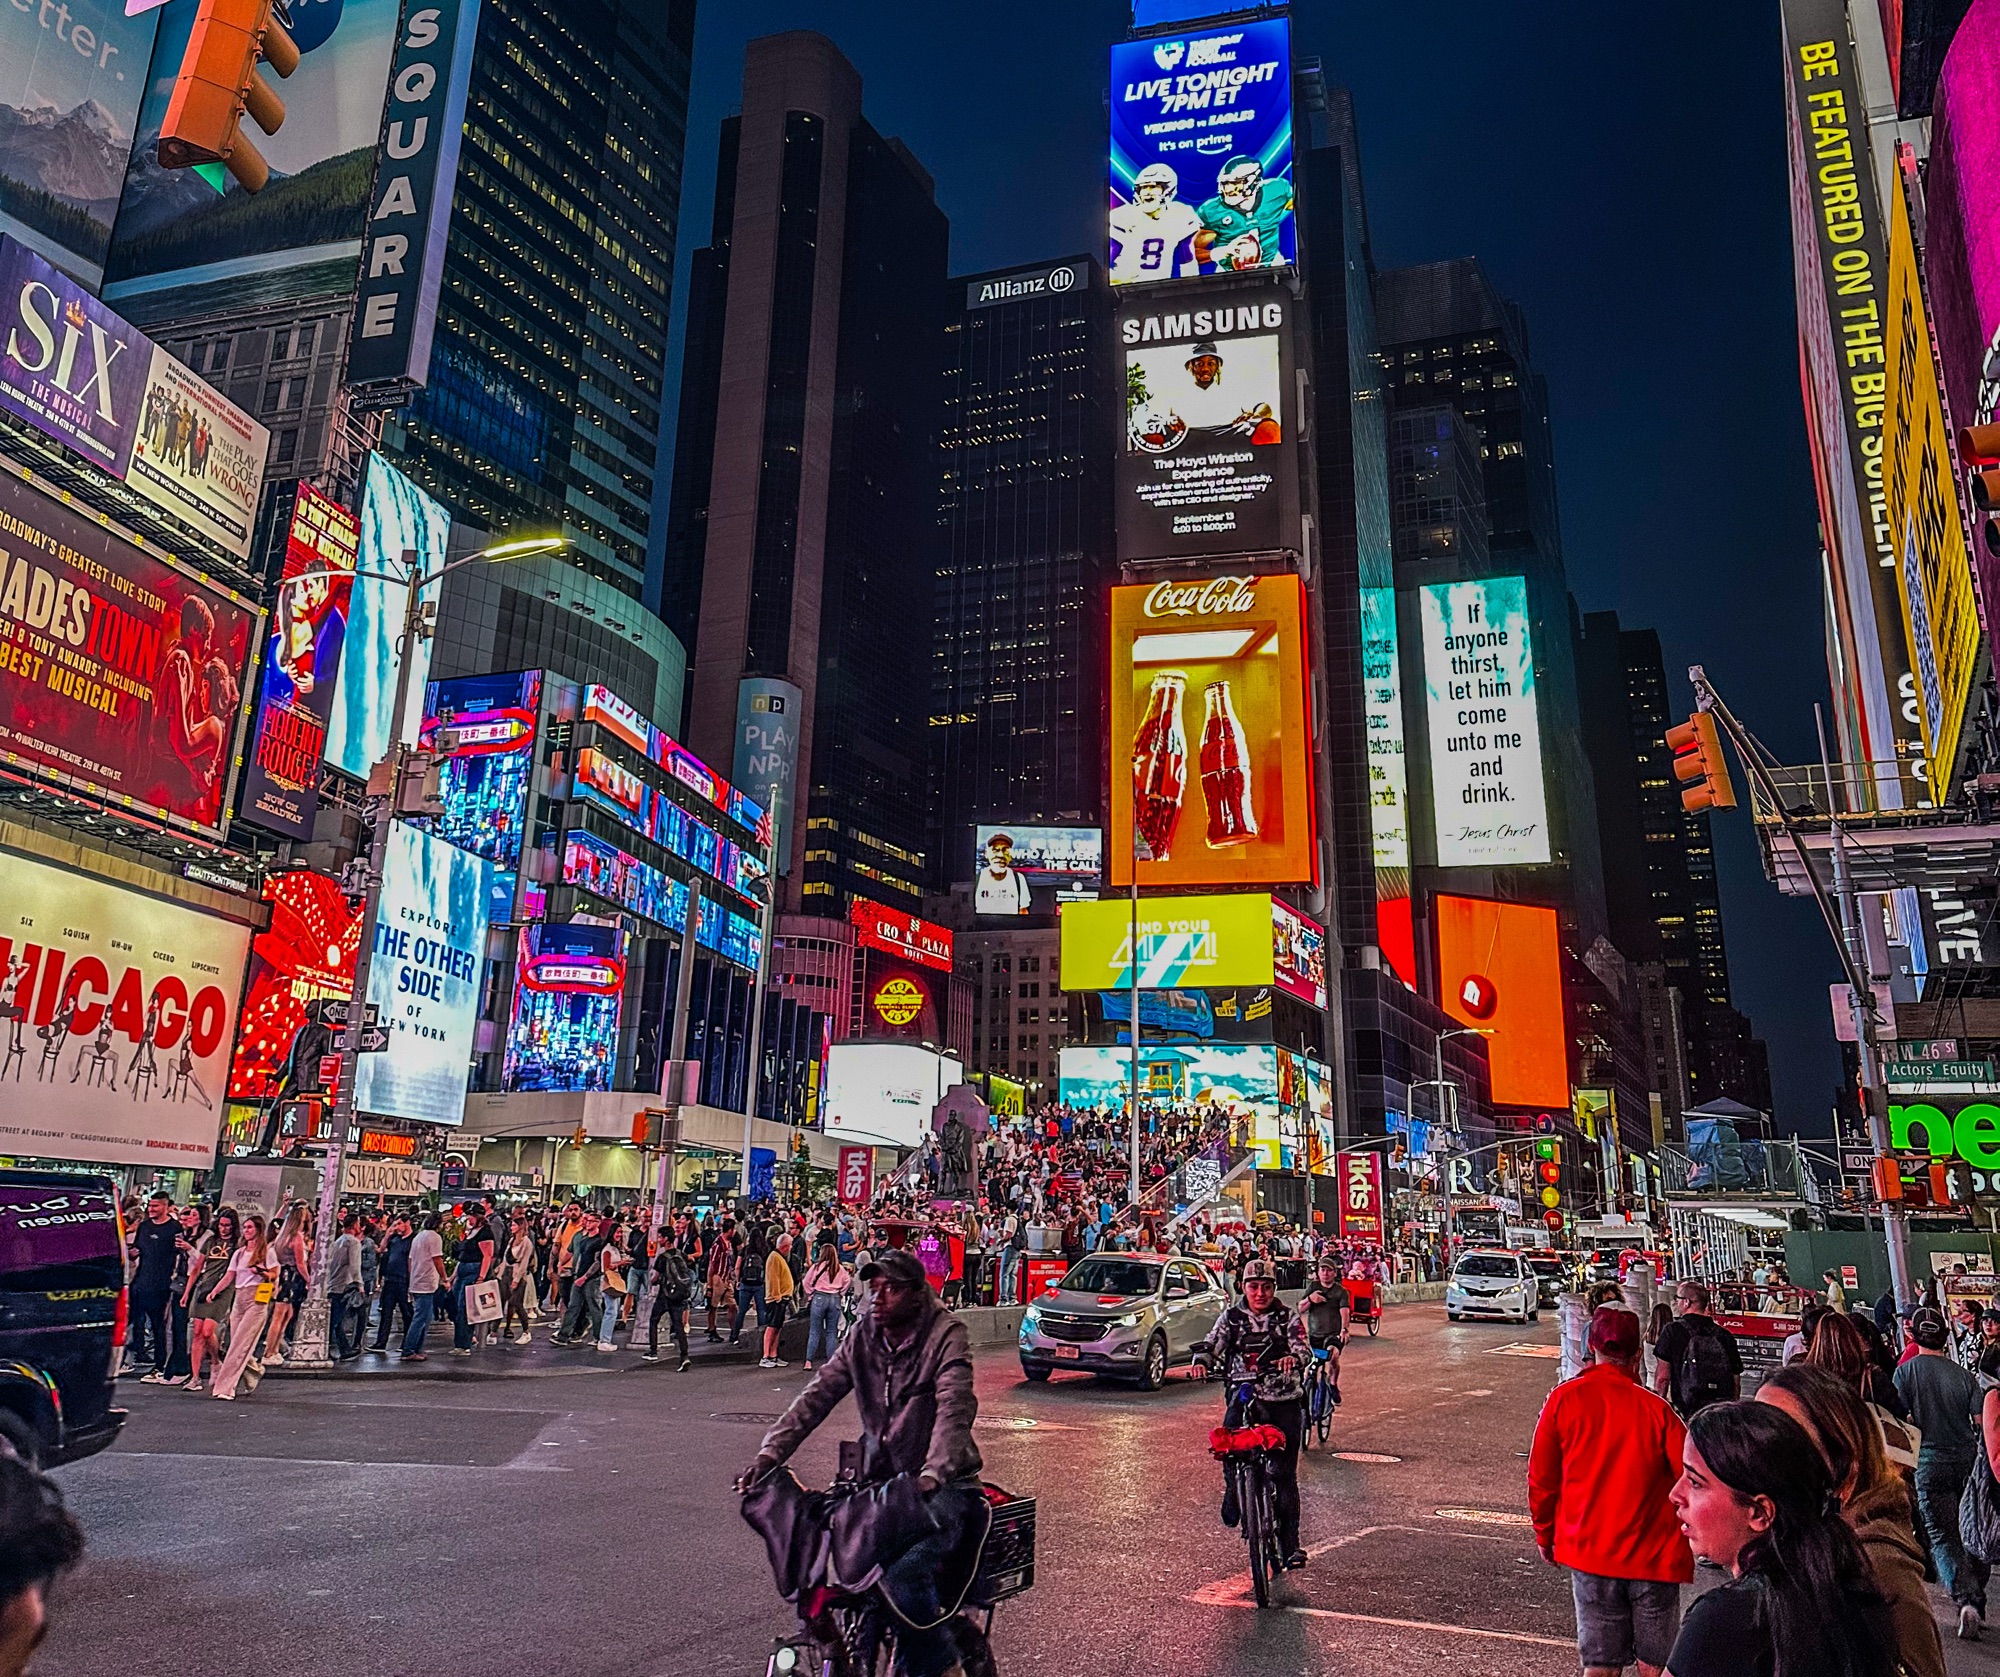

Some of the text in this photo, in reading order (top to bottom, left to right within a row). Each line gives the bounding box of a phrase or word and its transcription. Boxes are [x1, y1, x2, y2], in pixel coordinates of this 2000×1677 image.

[1124, 61, 1279, 102] LIVE TONIGHT
[1160, 85, 1242, 114] 7PM ET
[1144, 118, 1195, 135] VIKINGS
[1159, 134, 1233, 152] It's on prime
[361, 9, 442, 339] SQUARE
[1800, 41, 1886, 429] BE FEATURED ON THE BIG
[980, 277, 1045, 301] Allianz
[1122, 303, 1282, 345] SAMSUNG
[7, 282, 127, 426] SIX
[164, 372, 177, 385] AND
[31, 379, 93, 431] THE MUSICAL
[219, 436, 258, 471] THE PLAY
[1153, 452, 1253, 470] The Maya Winston
[213, 446, 259, 489] THAT GOES
[1172, 466, 1235, 481] Experience
[160, 476, 179, 494] WORLD
[179, 489, 197, 506] STAGES
[209, 459, 255, 510] WRONG
[1136, 483, 1152, 493] Join
[1162, 482, 1173, 491] for
[1185, 480, 1215, 488] evening
[1216, 478, 1225, 486] of
[1154, 499, 1171, 507] with
[1202, 495, 1218, 503] and
[1173, 512, 1235, 525] September 13
[1192, 524, 1202, 532] to
[58, 544, 168, 614] GREATEST LOVE STORY
[1144, 575, 1255, 618] Coca-Cola
[1468, 604, 1481, 624] If
[1444, 630, 1508, 655] anyone
[17, 628, 25, 643] 8
[29, 633, 56, 657] TONY
[103, 668, 152, 702] INCLUDING
[1451, 653, 1505, 676] thirst,
[0, 641, 117, 717] BEST MUSICAL
[1449, 678, 1512, 701] let him
[1457, 707, 1507, 726] come
[262, 704, 316, 757] MOULIN
[1447, 732, 1522, 753] unto me
[1470, 755, 1503, 777] and
[264, 792, 299, 813] NOW ON
[1462, 781, 1516, 805] drink.
[255, 799, 303, 824] BROADWAY
[1458, 823, 1538, 841] Jesus Christ
[1011, 849, 1040, 860] WHO
[1044, 860, 1098, 870] THE CALL
[20, 916, 34, 927] SIX
[400, 907, 457, 937] EXPLORE
[1168, 919, 1210, 933] YOUR
[63, 928, 90, 941] SQUISH
[111, 940, 133, 953] UH-UH
[153, 951, 175, 963] CICERO
[372, 922, 475, 984] THE OTHER
[922, 936, 950, 957] PLAZA
[191, 961, 220, 975] LIPSCHITZ
[398, 966, 442, 1003] SIDE
[889, 981, 911, 994] HOT
[329, 1006, 346, 1018] ONE
[407, 1005, 422, 1017] OF
[381, 1015, 406, 1032] NEW
[415, 1024, 447, 1042] YORK
[363, 1035, 381, 1045] WAY
[1900, 1042, 1956, 1060] W 46 St
[1891, 1064, 1984, 1078] Actors' Equity
[31, 1129, 64, 1138] BROADWAY
[347, 1163, 421, 1192] SWAROVSKI
[846, 1150, 867, 1199] tkts
[1448, 1157, 1485, 1195] R
[1548, 1168, 1556, 1176] m
[236, 1189, 263, 1198] GEORGE
[1347, 1158, 1373, 1210] tkts
[1550, 1217, 1559, 1225] m
